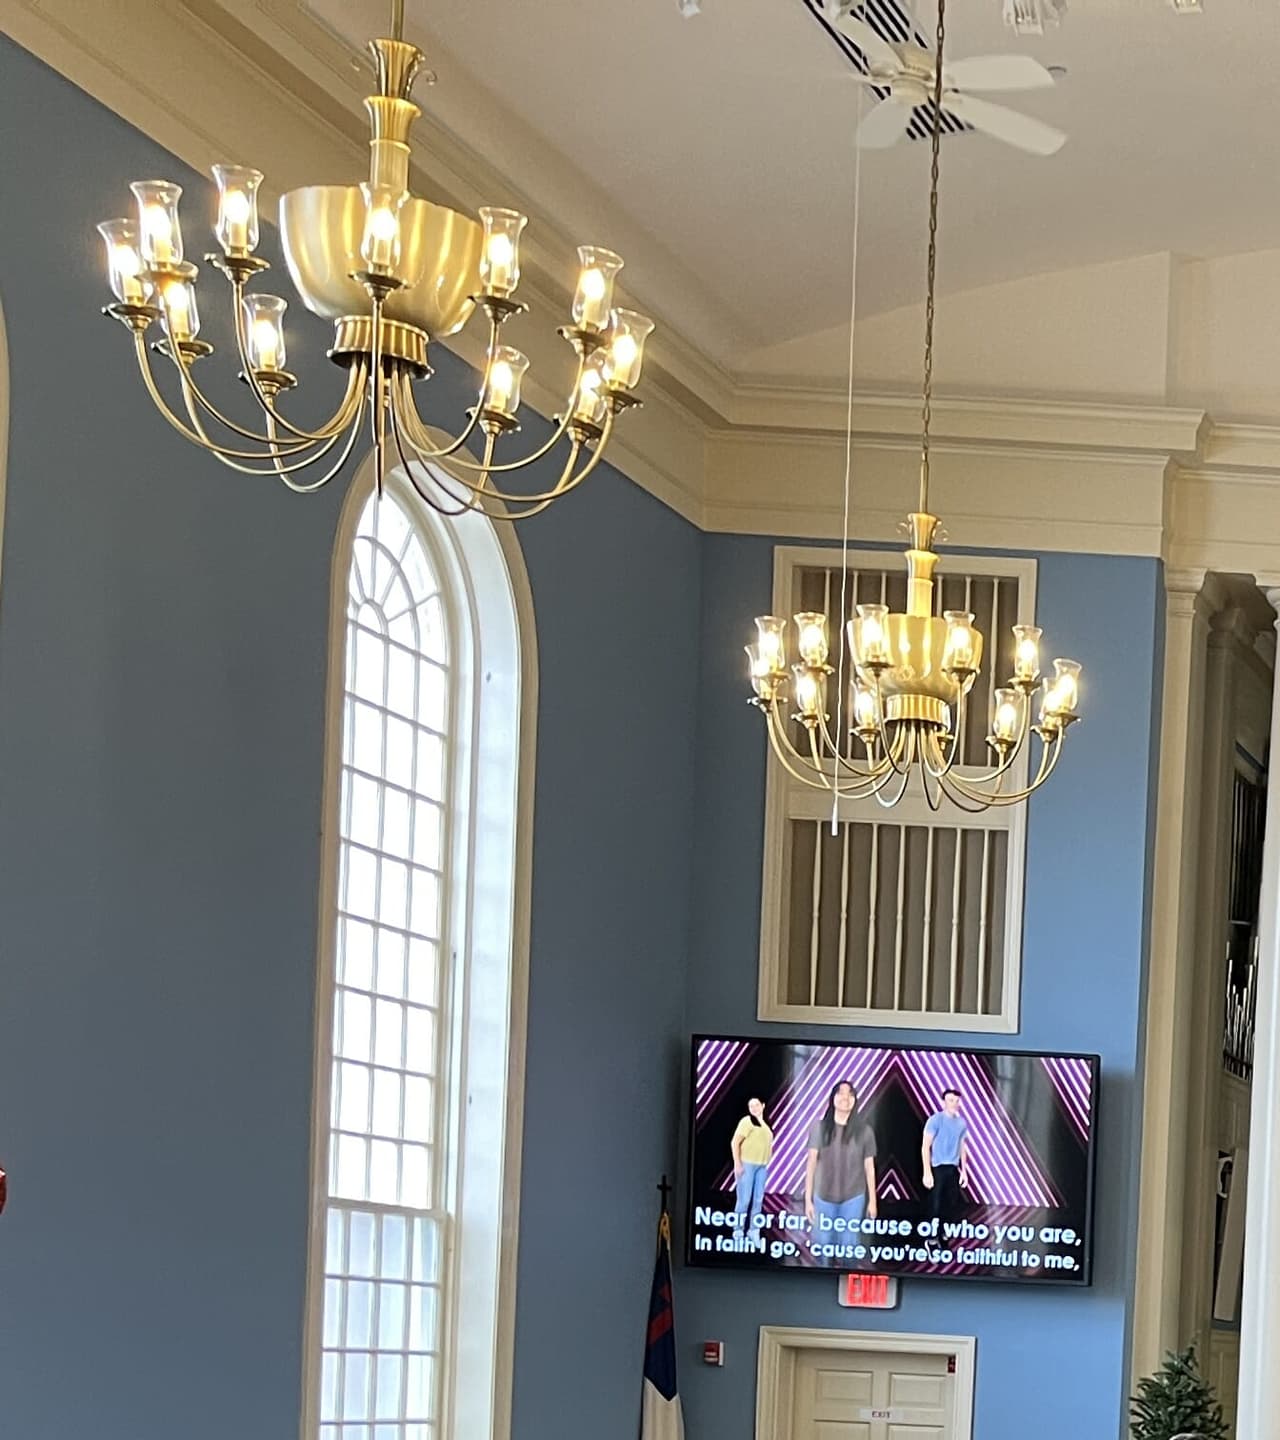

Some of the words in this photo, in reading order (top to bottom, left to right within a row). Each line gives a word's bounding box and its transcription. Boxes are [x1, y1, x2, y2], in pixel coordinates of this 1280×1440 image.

[695, 1207, 747, 1227] Near
[753, 1213, 774, 1228] or
[778, 1210, 812, 1232] far,
[820, 1213, 912, 1236] because
[917, 1218, 940, 1237] of
[944, 1220, 989, 1239] who
[994, 1224, 1034, 1244] you
[1039, 1228, 1081, 1246] are,
[695, 1234, 712, 1251] In
[716, 1235, 755, 1253] faith
[760, 1239, 766, 1253] I
[770, 1241, 800, 1258] go,
[932, 1249, 952, 1264] so
[957, 1247, 1017, 1266] faithful
[1022, 1249, 1040, 1267] to
[1044, 1254, 1080, 1271] me,
[847, 1274, 890, 1304] EXIT
[871, 1410, 890, 1419] EXIT
